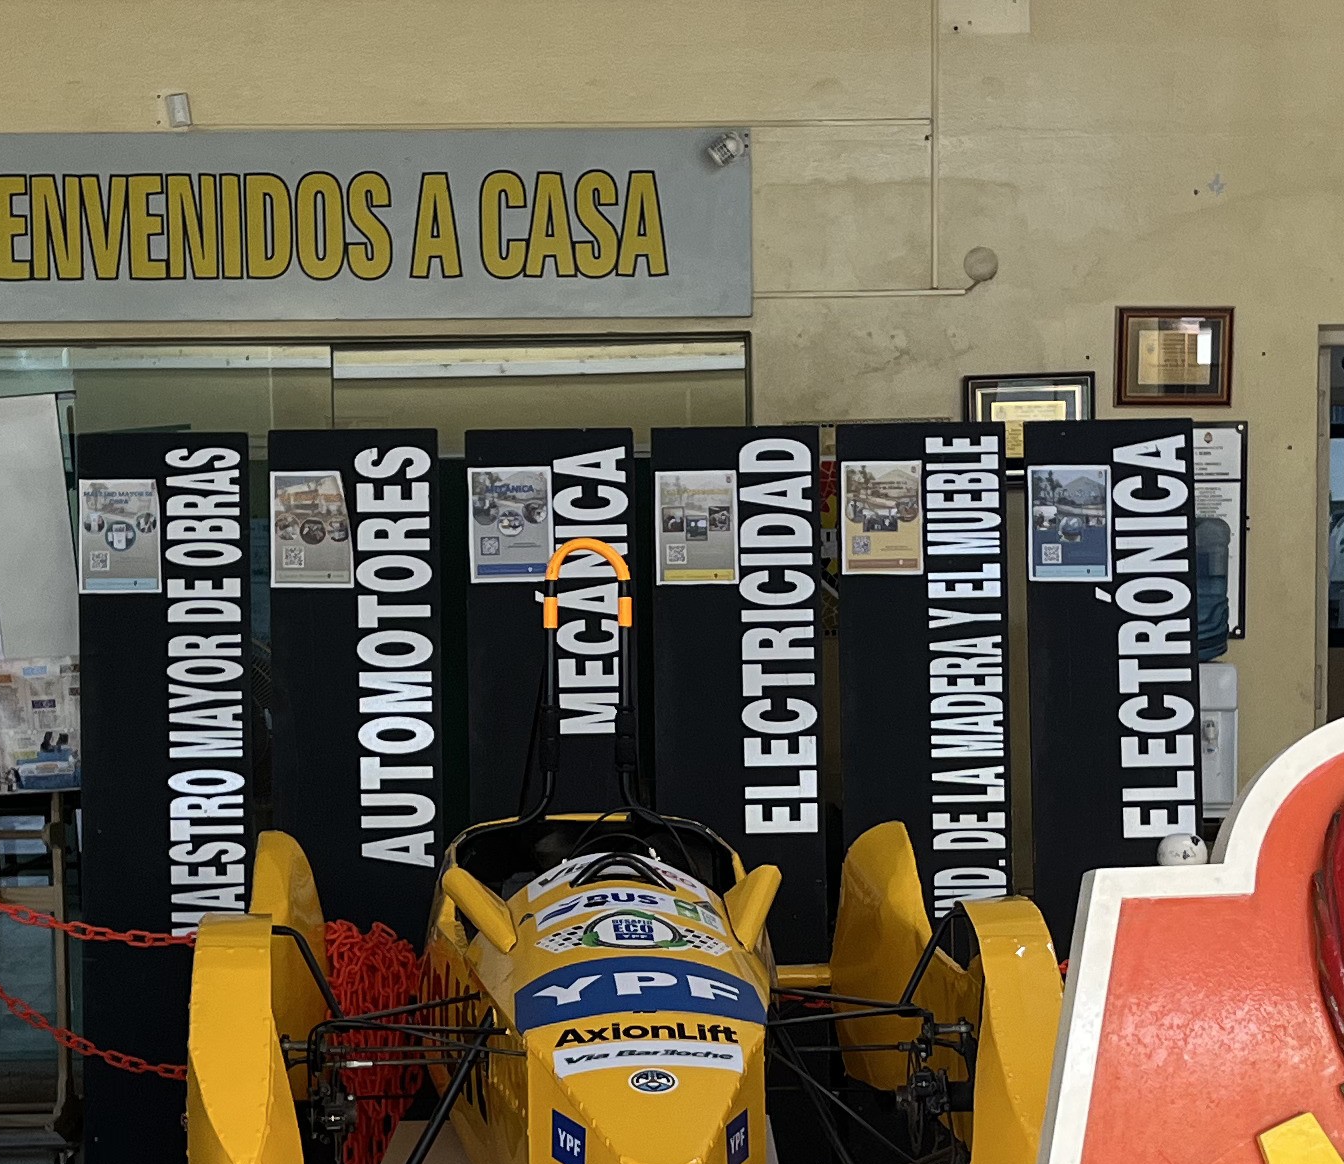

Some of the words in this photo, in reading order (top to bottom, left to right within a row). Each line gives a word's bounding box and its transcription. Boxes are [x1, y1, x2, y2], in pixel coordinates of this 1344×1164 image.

[411, 172, 462, 279] A
[479, 170, 669, 278] CASA
[164, 446, 242, 567] OBRAS
[925, 435, 1002, 556] MUEBLE
[167, 577, 242, 624] DE
[927, 563, 1002, 599] EL
[738, 437, 819, 834] ELECTRICIDAD
[928, 606, 1002, 629] Y
[1095, 434, 1197, 839] ELECTRÓNICA
[355, 445, 436, 868] AUTOMOTORES
[166, 633, 244, 759] MAYOR
[929, 635, 1004, 758] MADERA
[931, 765, 1005, 803] LA
[932, 811, 1006, 851] DE
[532, 971, 740, 1006] YPF
[555, 1022, 739, 1048] AxionLift
[557, 1127, 581, 1157] YPF
[729, 1126, 745, 1155] YPF
